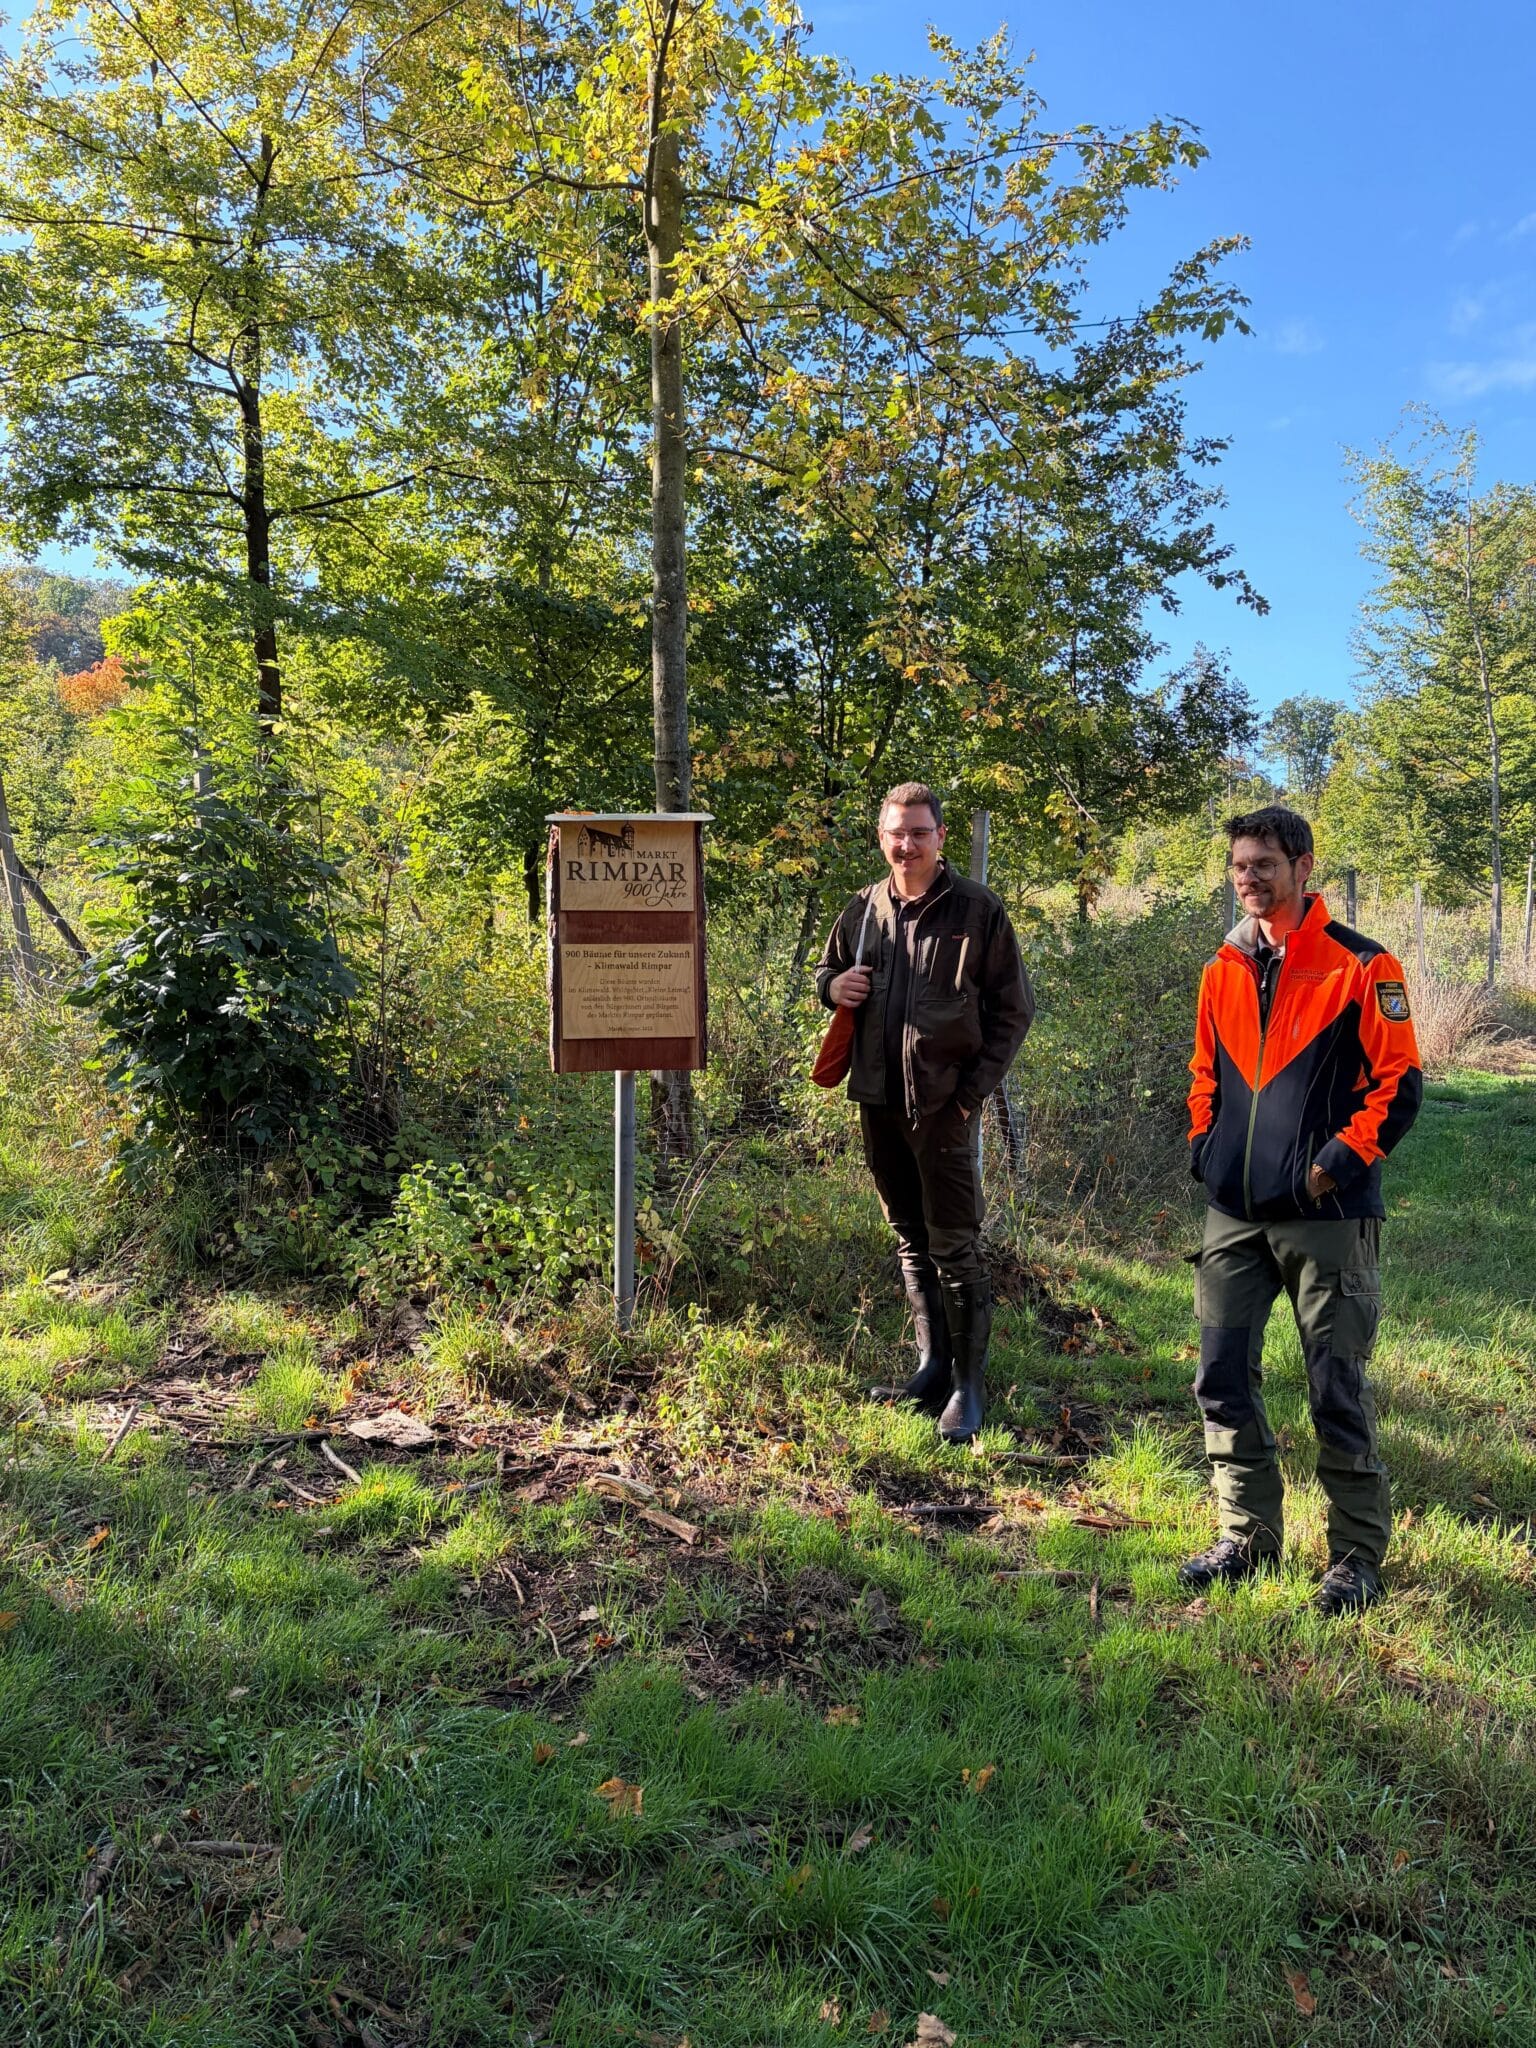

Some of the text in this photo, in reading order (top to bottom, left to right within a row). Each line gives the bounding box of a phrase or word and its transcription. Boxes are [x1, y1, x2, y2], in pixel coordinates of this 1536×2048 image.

[636, 850, 678, 860] MARKT
[566, 861, 687, 882] RIMPAR
[623, 880, 688, 907] 900 Jahre
[565, 950, 690, 959] 900 Bäume für unsere Zukunft
[594, 962, 639, 970] Klimawald
[641, 962, 673, 972] Rimpar
